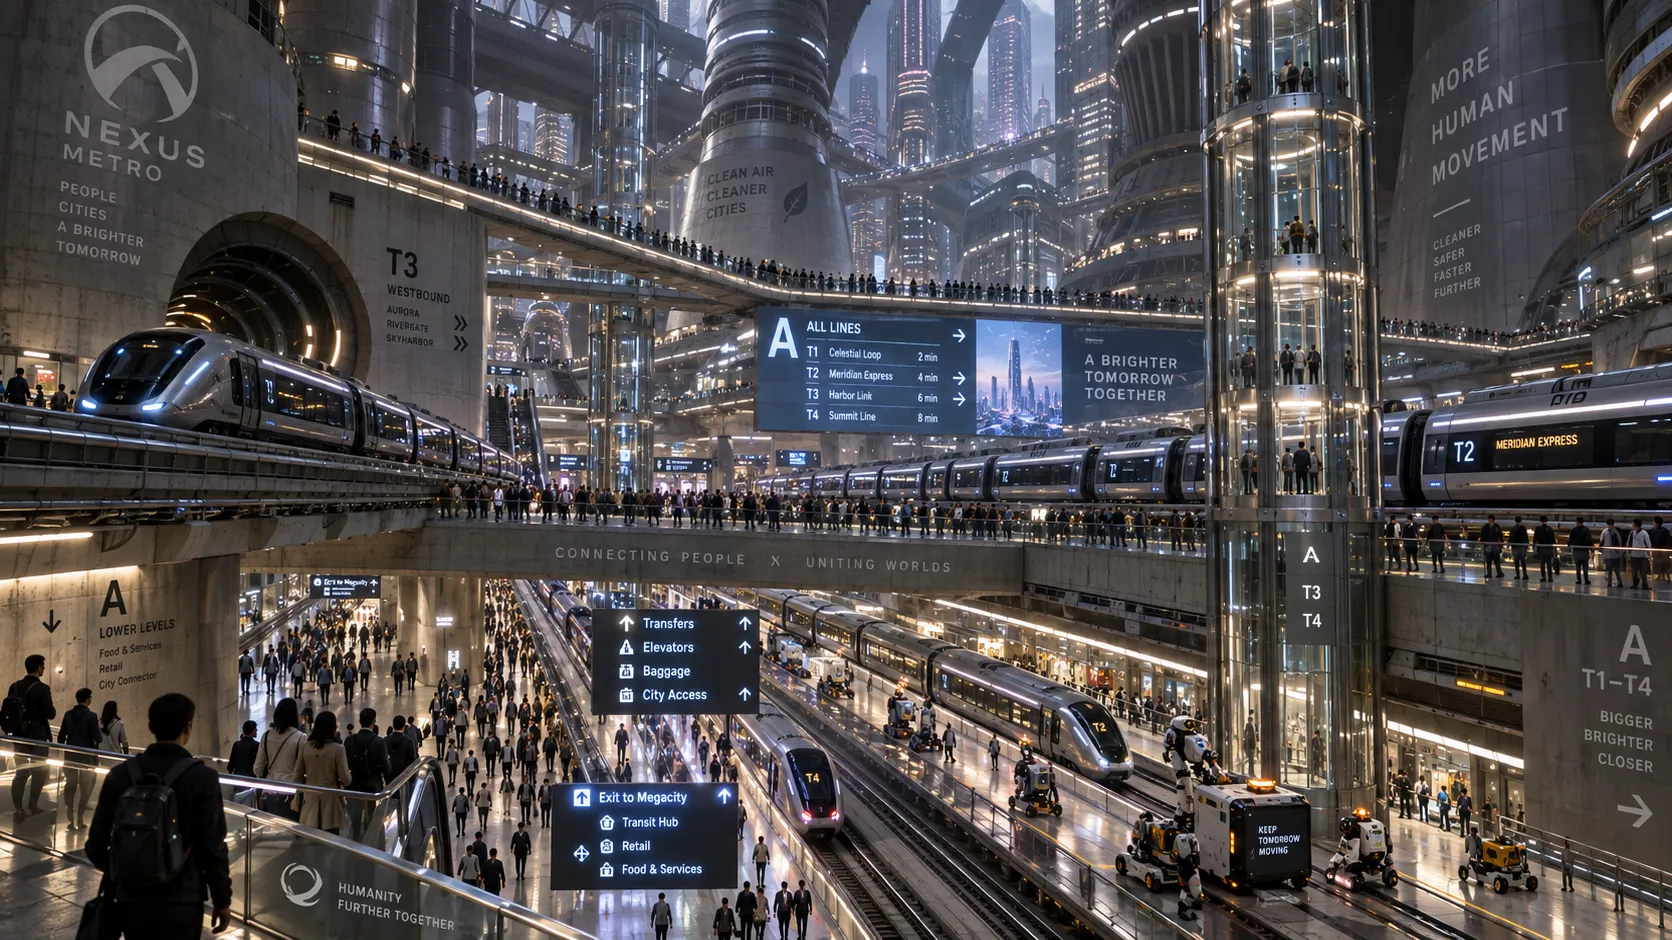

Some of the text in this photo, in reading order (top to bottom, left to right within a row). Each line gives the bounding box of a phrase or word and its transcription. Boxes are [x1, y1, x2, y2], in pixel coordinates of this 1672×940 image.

[1431, 46, 1490, 104] MORE
[1432, 80, 1514, 145] HUMAN
[65, 110, 205, 169] NEXUS
[1432, 106, 1568, 186] MOVEMENT
[63, 143, 162, 182] METRO
[708, 166, 774, 185] CLEAN AIR
[60, 181, 117, 203] PEOPLE
[707, 184, 767, 202] CLEANER
[59, 201, 107, 221] CITIES
[707, 202, 746, 219] CITIES
[57, 220, 144, 248] A BRIGHTER
[1433, 223, 1482, 251] CLEANER
[56, 240, 141, 266] TOMORROW
[1433, 247, 1465, 267] SAFER
[386, 247, 418, 279] T3
[1434, 262, 1472, 283] FASTER
[387, 284, 450, 304] WESTBOUND
[1434, 276, 1481, 299] FURTHER
[387, 305, 420, 318] AURORA
[386, 319, 429, 333] RIVERGATE
[807, 321, 861, 334] ALL LINES
[386, 333, 434, 347] SKYHARBOR
[768, 317, 799, 359] A
[807, 346, 938, 362] T1 Celestial Loop 2 min
[1084, 354, 1178, 369] A BRIGHTER
[807, 367, 938, 382] T2 Meridian Express 4 min
[1084, 370, 1174, 386] TOMORROW
[807, 388, 938, 403] T3 Harbor Link 6 min
[1084, 387, 1167, 402] TOGETHER
[807, 409, 938, 423] T4 Summit Line 8 min
[1496, 434, 1578, 450] MERIDIAN EXPRESS
[1453, 440, 1475, 463] T2
[555, 547, 950, 573] CONNECTING PEOPLE X UNITING WORLDS
[1302, 546, 1320, 563] A
[100, 579, 127, 617] A
[1302, 585, 1321, 600] T3
[100, 619, 175, 639] LOWER LEVELS
[643, 618, 694, 629] Transfers
[1302, 613, 1322, 628] T4
[99, 641, 162, 658] Food & Services
[643, 641, 694, 653] Elevators
[1619, 624, 1652, 665] A
[99, 661, 123, 674] Retail
[643, 665, 691, 679] Baggage
[98, 671, 158, 690] City Connector
[643, 689, 707, 702] City Access
[1092, 722, 1107, 732] T2
[1600, 710, 1653, 730] BIGGER
[1584, 729, 1653, 752] BRIGHTER
[1598, 752, 1653, 772] CLOSER
[805, 773, 820, 783] T4
[600, 791, 687, 805] Exit to Megacity
[622, 817, 678, 828] Transit Hub
[622, 841, 651, 851] Retail
[1258, 846, 1288, 855] MOVING
[622, 864, 702, 875] Food & Services
[338, 882, 402, 903] HUMANITY
[338, 899, 455, 931] FURTHER TOGETHER
